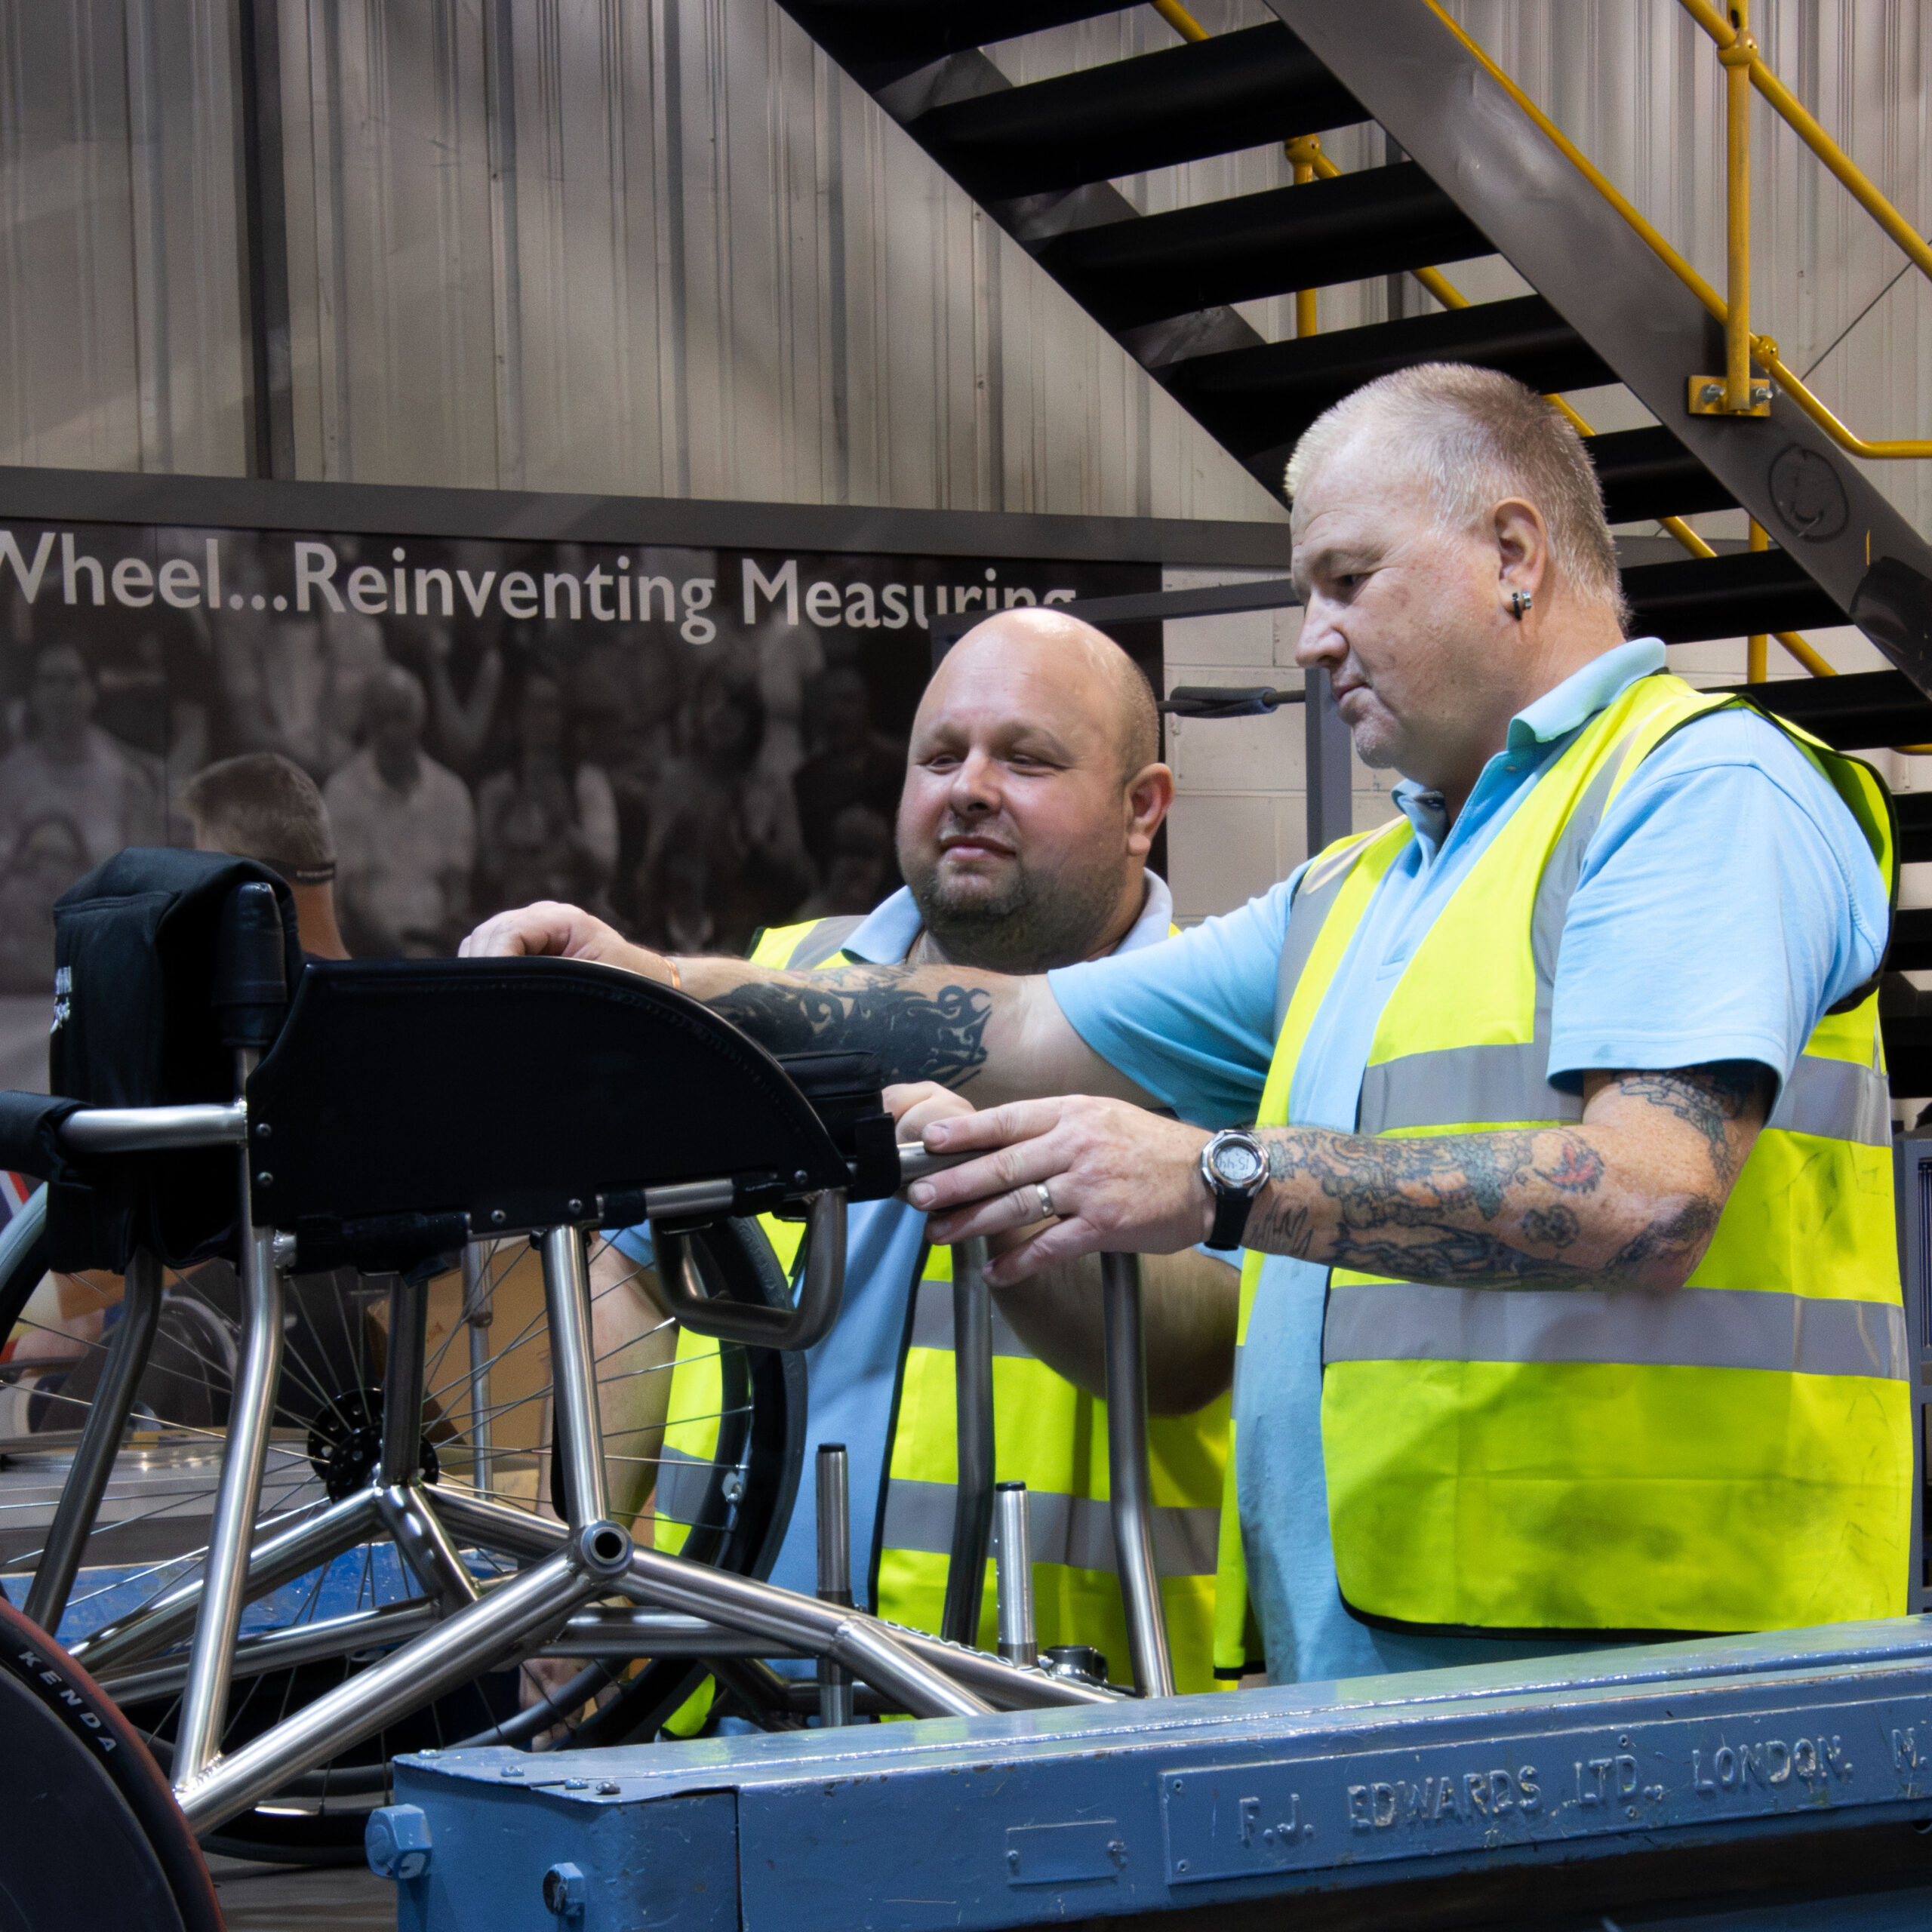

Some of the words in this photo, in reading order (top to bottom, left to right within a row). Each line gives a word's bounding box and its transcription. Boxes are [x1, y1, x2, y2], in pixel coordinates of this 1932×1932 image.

[742, 558, 1077, 629] Measurin
[18, 1651, 117, 1752] KENDA
[1347, 1764, 1542, 1830] EDWARDS
[1692, 1736, 1854, 1792] LONDON.
